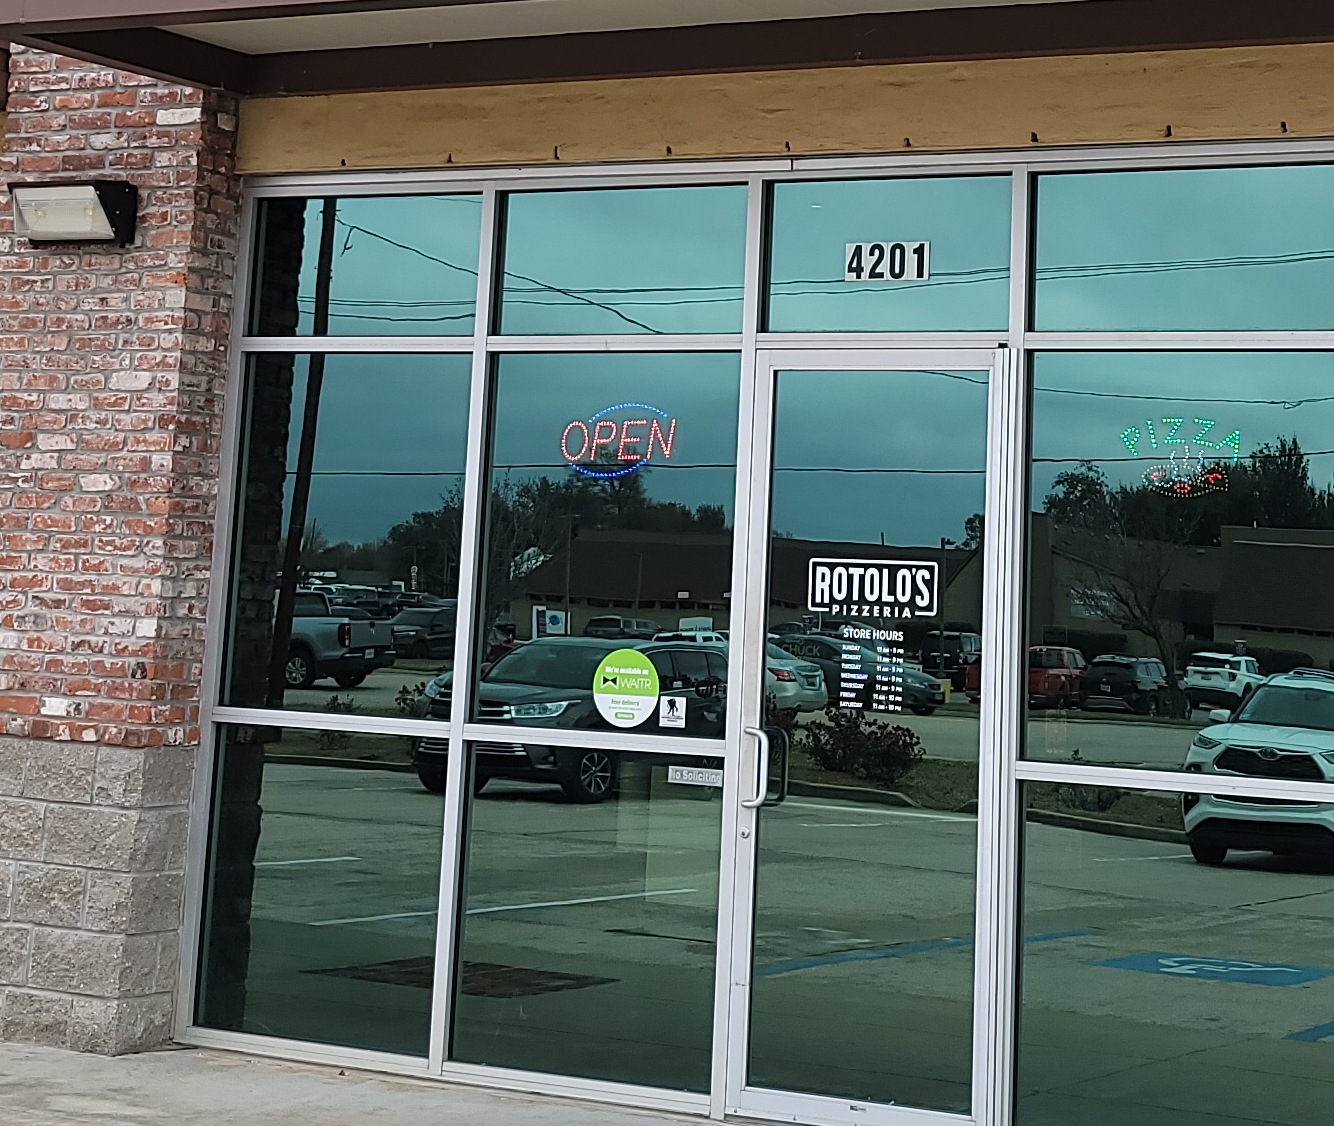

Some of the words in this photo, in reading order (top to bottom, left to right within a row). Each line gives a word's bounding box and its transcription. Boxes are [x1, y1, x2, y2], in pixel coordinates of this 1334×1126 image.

[847, 242, 926, 279] 4201
[560, 417, 678, 462] OPEN
[1120, 417, 1241, 462] PIZZA
[815, 565, 931, 608] ROTOLO'S
[831, 604, 912, 619] PIZZERIA
[843, 628, 871, 640] STORE
[872, 629, 904, 642] HOURS
[620, 677, 652, 690] WAITR
[671, 768, 681, 780] No
[682, 770, 721, 784] Soliciting
